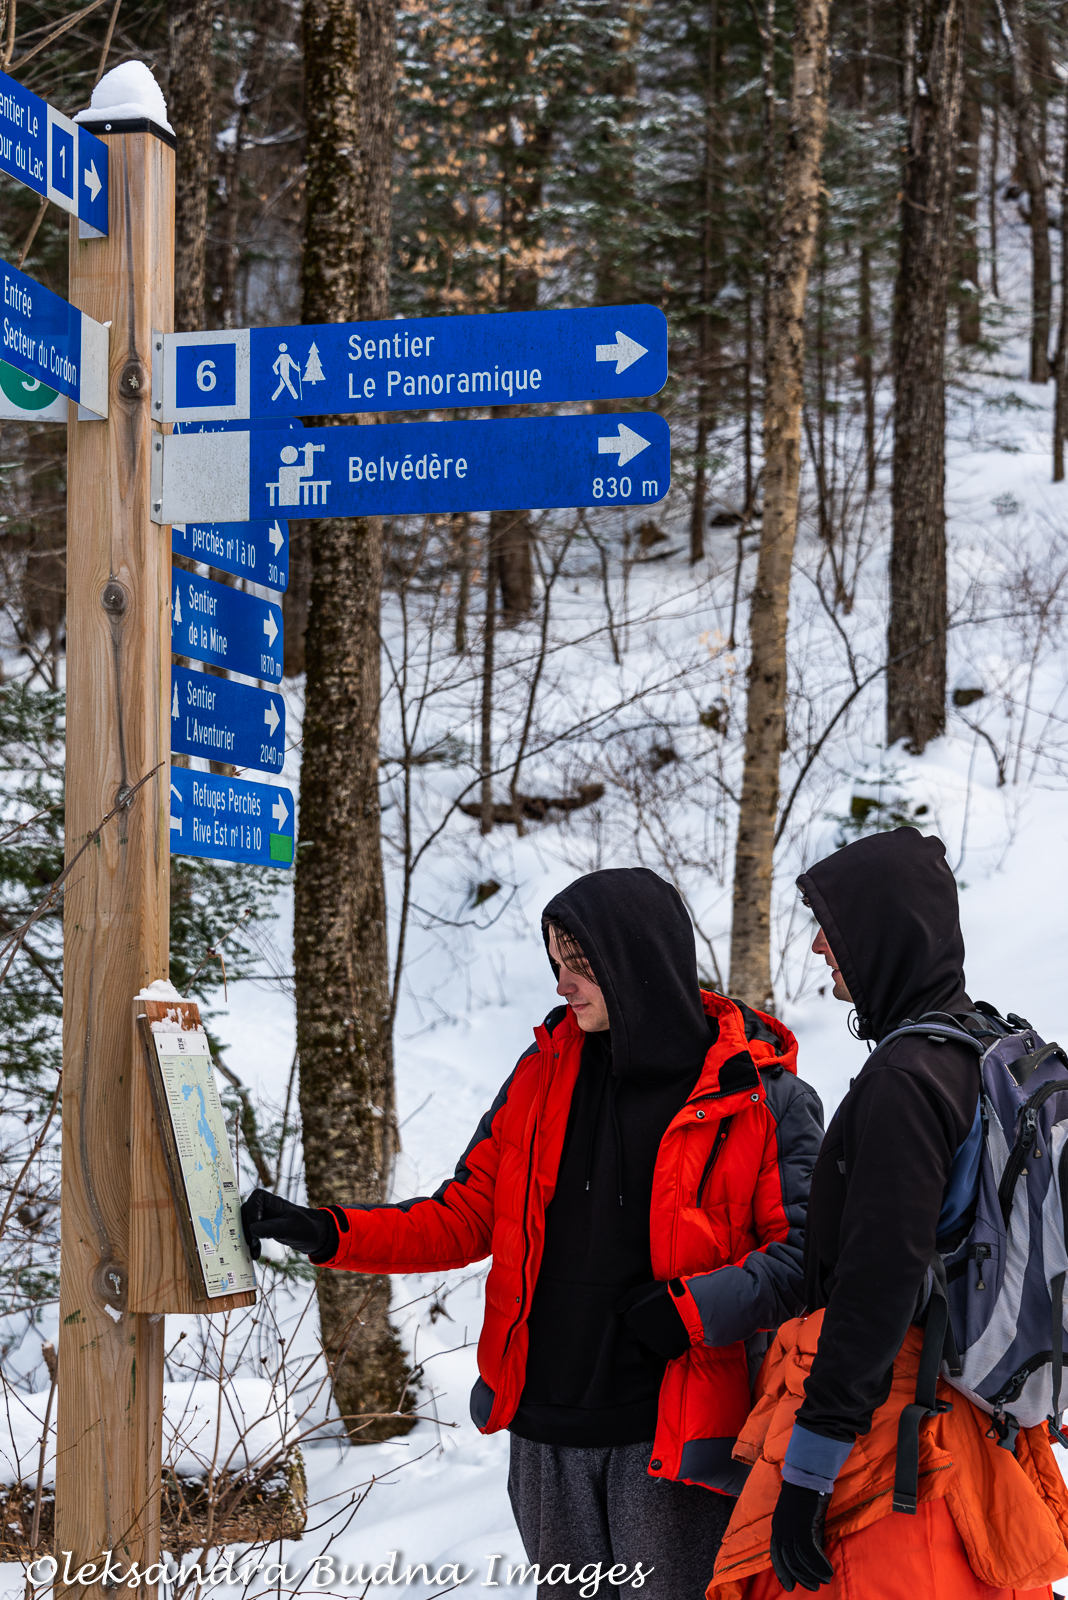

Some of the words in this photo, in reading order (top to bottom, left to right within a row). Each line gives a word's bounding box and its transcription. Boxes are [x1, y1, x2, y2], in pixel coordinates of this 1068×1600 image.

[0, 92, 25, 128] entier
[27, 105, 39, 138] Le
[0, 133, 13, 161] our
[15, 140, 26, 170] du
[28, 146, 44, 182] Lac
[59, 145, 66, 179] 1
[4, 275, 32, 318] Entrée
[3, 317, 36, 361] Secteur
[38, 339, 48, 369] du
[50, 345, 77, 386] Cordon
[347, 331, 435, 361] Sentier
[196, 359, 217, 392] 6
[348, 372, 376, 399] Le
[387, 365, 542, 398] Panoramique
[348, 453, 468, 483] Belvédère
[592, 477, 632, 499] 830
[642, 479, 658, 497] m
[192, 527, 224, 557] perchés
[240, 540, 246, 565] à
[247, 543, 256, 569] 10
[279, 571, 286, 587] m
[188, 584, 217, 616] Sentier
[188, 621, 198, 646] de
[200, 624, 208, 649] la
[210, 626, 228, 656] Mine
[260, 653, 275, 676] 1870
[275, 662, 282, 678] m
[186, 680, 217, 711] Sentier
[186, 716, 235, 751] L'Aventurier
[260, 744, 277, 765] 2040
[277, 751, 284, 767] m
[192, 781, 226, 817] Refuges
[228, 787, 261, 817] Perchés
[192, 817, 211, 845] Rive
[214, 820, 228, 846] Est
[245, 823, 251, 850] à
[253, 827, 262, 851] 10
